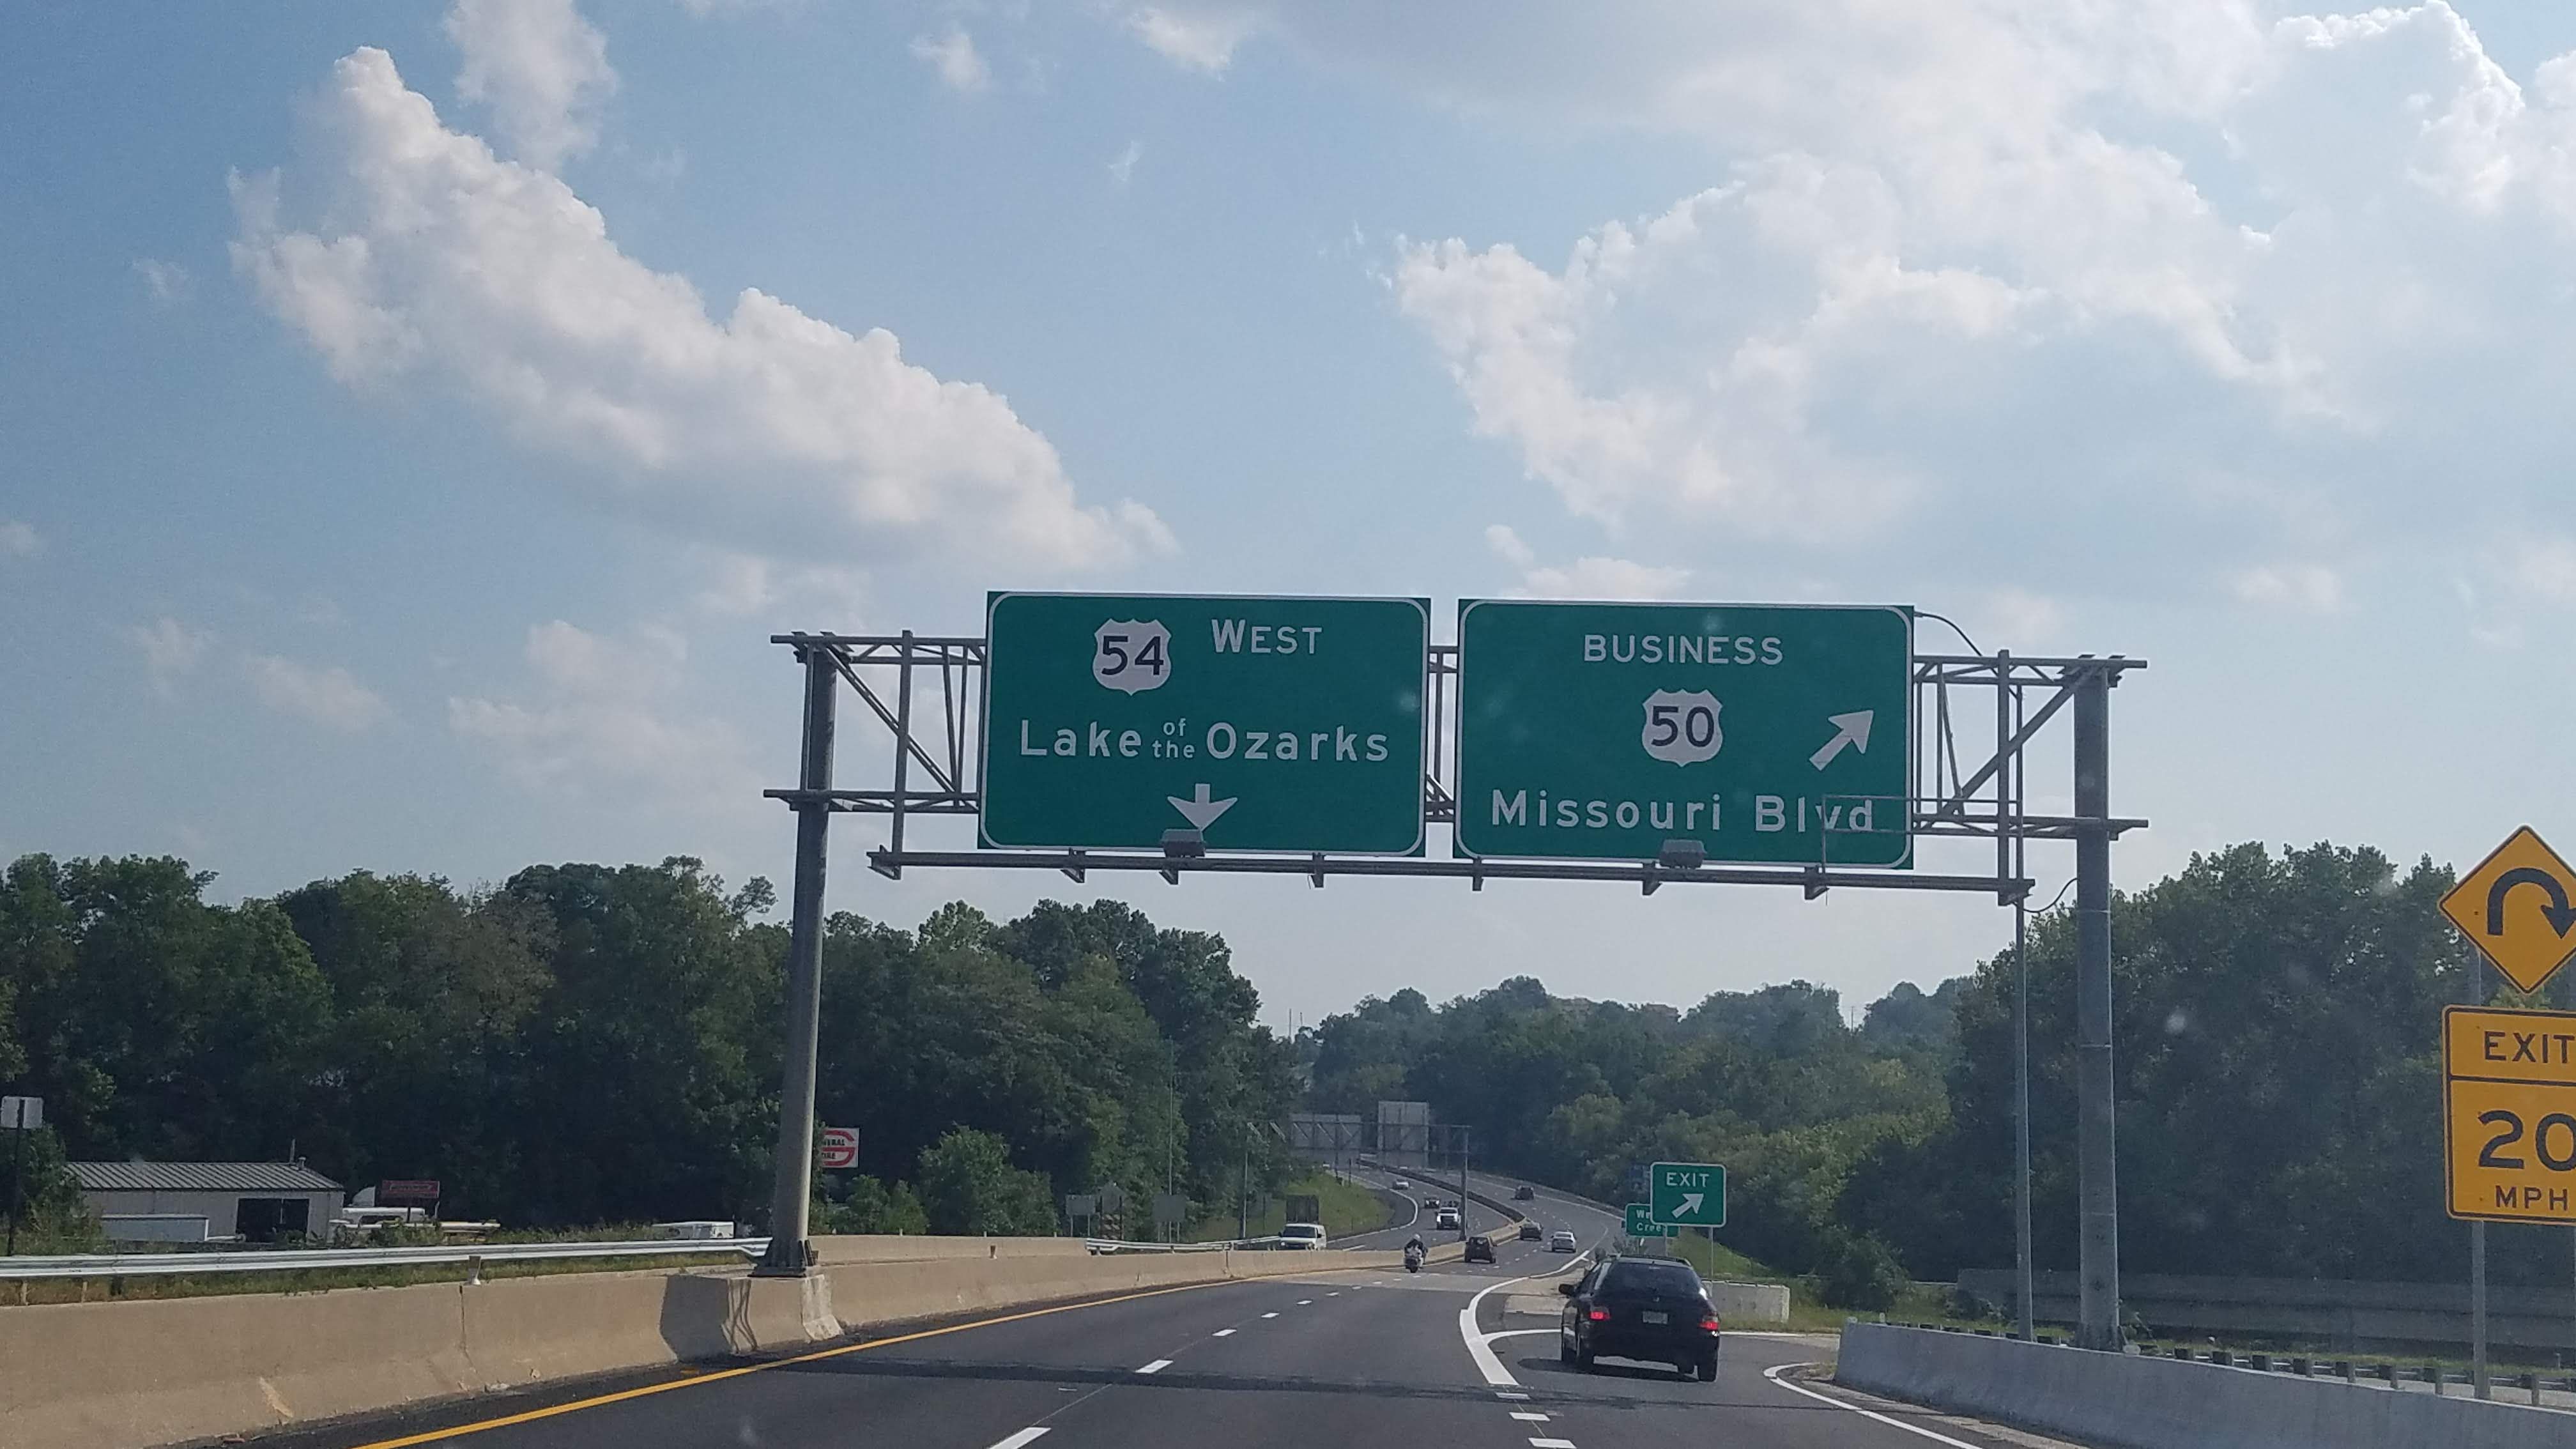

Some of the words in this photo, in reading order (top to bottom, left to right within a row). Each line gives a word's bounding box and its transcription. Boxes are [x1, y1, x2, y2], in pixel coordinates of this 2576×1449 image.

[1100, 636, 1164, 676] 54
[1211, 618, 1322, 655] WEST
[1584, 634, 1783, 665] BUSINESS
[1021, 719, 1142, 757] Lake
[1163, 718, 1186, 736] of
[1206, 723, 1389, 762] Ozarks
[1650, 705, 1715, 747] 50
[1152, 740, 1195, 759] the
[1491, 790, 1721, 830] Missouri
[1755, 795, 1873, 832] Blvd
[2484, 1031, 2575, 1064] EXIT
[2478, 1110, 2576, 1172] 20
[1666, 1172, 1710, 1187] EXIT
[2495, 1185, 2568, 1211] MPH
[1636, 1222, 1664, 1232] Cree
